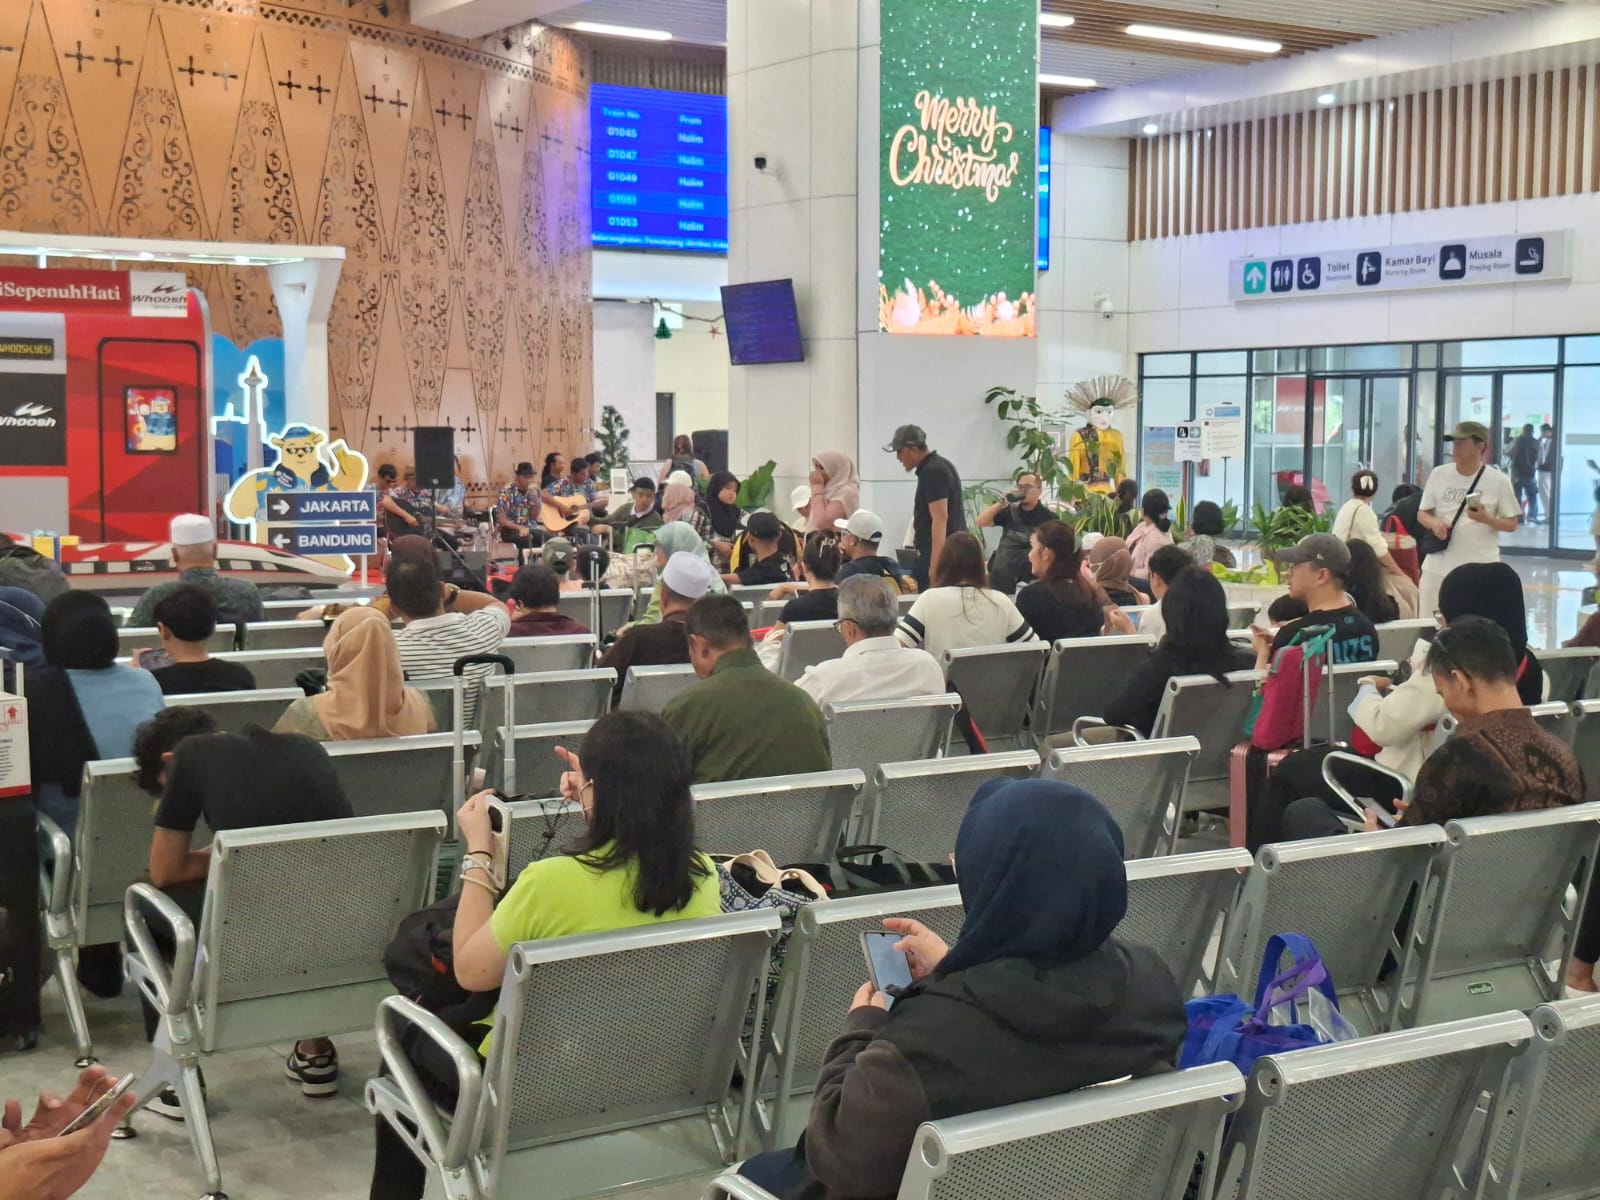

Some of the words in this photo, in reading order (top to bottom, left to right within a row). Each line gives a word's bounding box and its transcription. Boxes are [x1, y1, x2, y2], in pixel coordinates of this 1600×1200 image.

[913, 89, 1014, 153] Merry
[889, 124, 1019, 203] Christmas
[1385, 256, 1414, 267] Kamar
[1415, 254, 1436, 267] Bayi
[1469, 249, 1502, 260] Musala
[1327, 262, 1350, 273] Toilet
[132, 294, 187, 304] Whoosh
[300, 500, 370, 513] JAKARTA
[298, 534, 372, 547] BANDUNG
